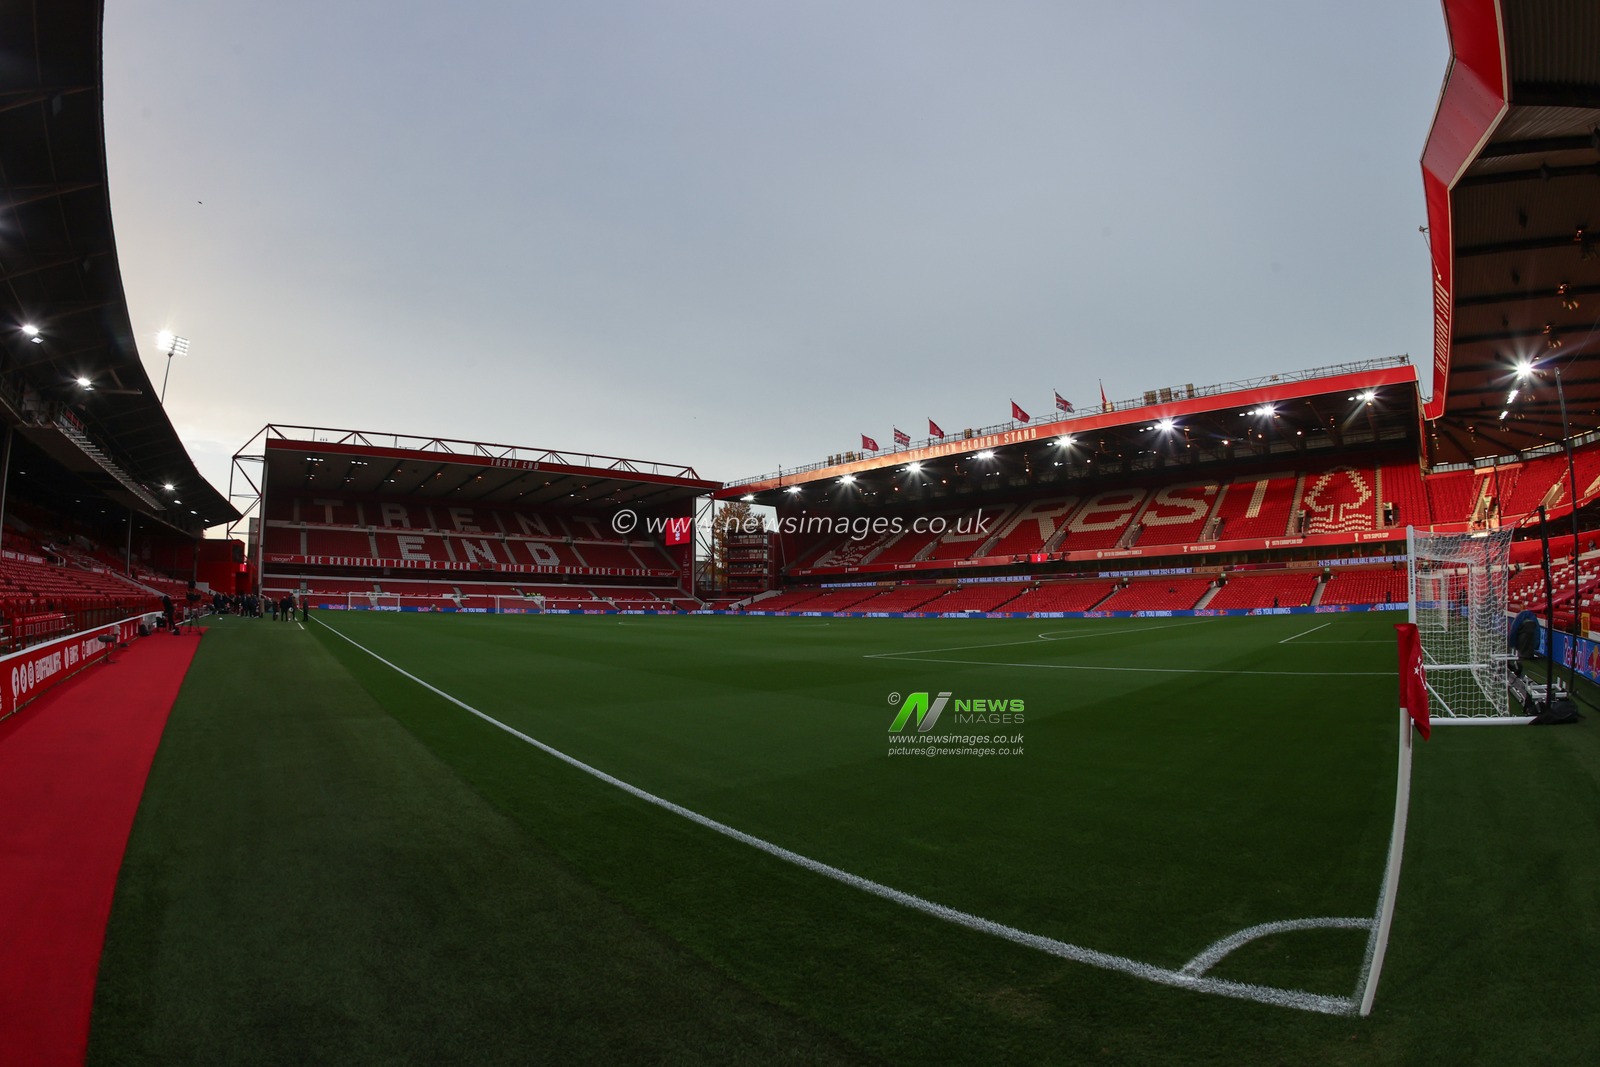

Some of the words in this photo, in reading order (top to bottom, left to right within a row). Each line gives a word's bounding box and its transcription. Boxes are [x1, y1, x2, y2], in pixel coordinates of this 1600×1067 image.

[908, 449, 925, 461] THE
[929, 442, 957, 459] BRIAN
[961, 435, 999, 452] CLOUGH
[1003, 427, 1037, 443] STAND
[490, 458, 519, 469] TRENT
[522, 461, 540, 471] END
[313, 499, 604, 540] TRENT
[304, 555, 322, 565] THE
[329, 556, 386, 568] GARIBALDI
[393, 559, 418, 569] THAT
[424, 560, 438, 570] WE
[444, 561, 471, 571] WEAR
[500, 563, 525, 573] WITH
[531, 564, 560, 574] PRIDE
[564, 566, 583, 575] WAS
[588, 567, 611, 576] MADE
[616, 568, 626, 576] IN
[397, 535, 562, 566] END
